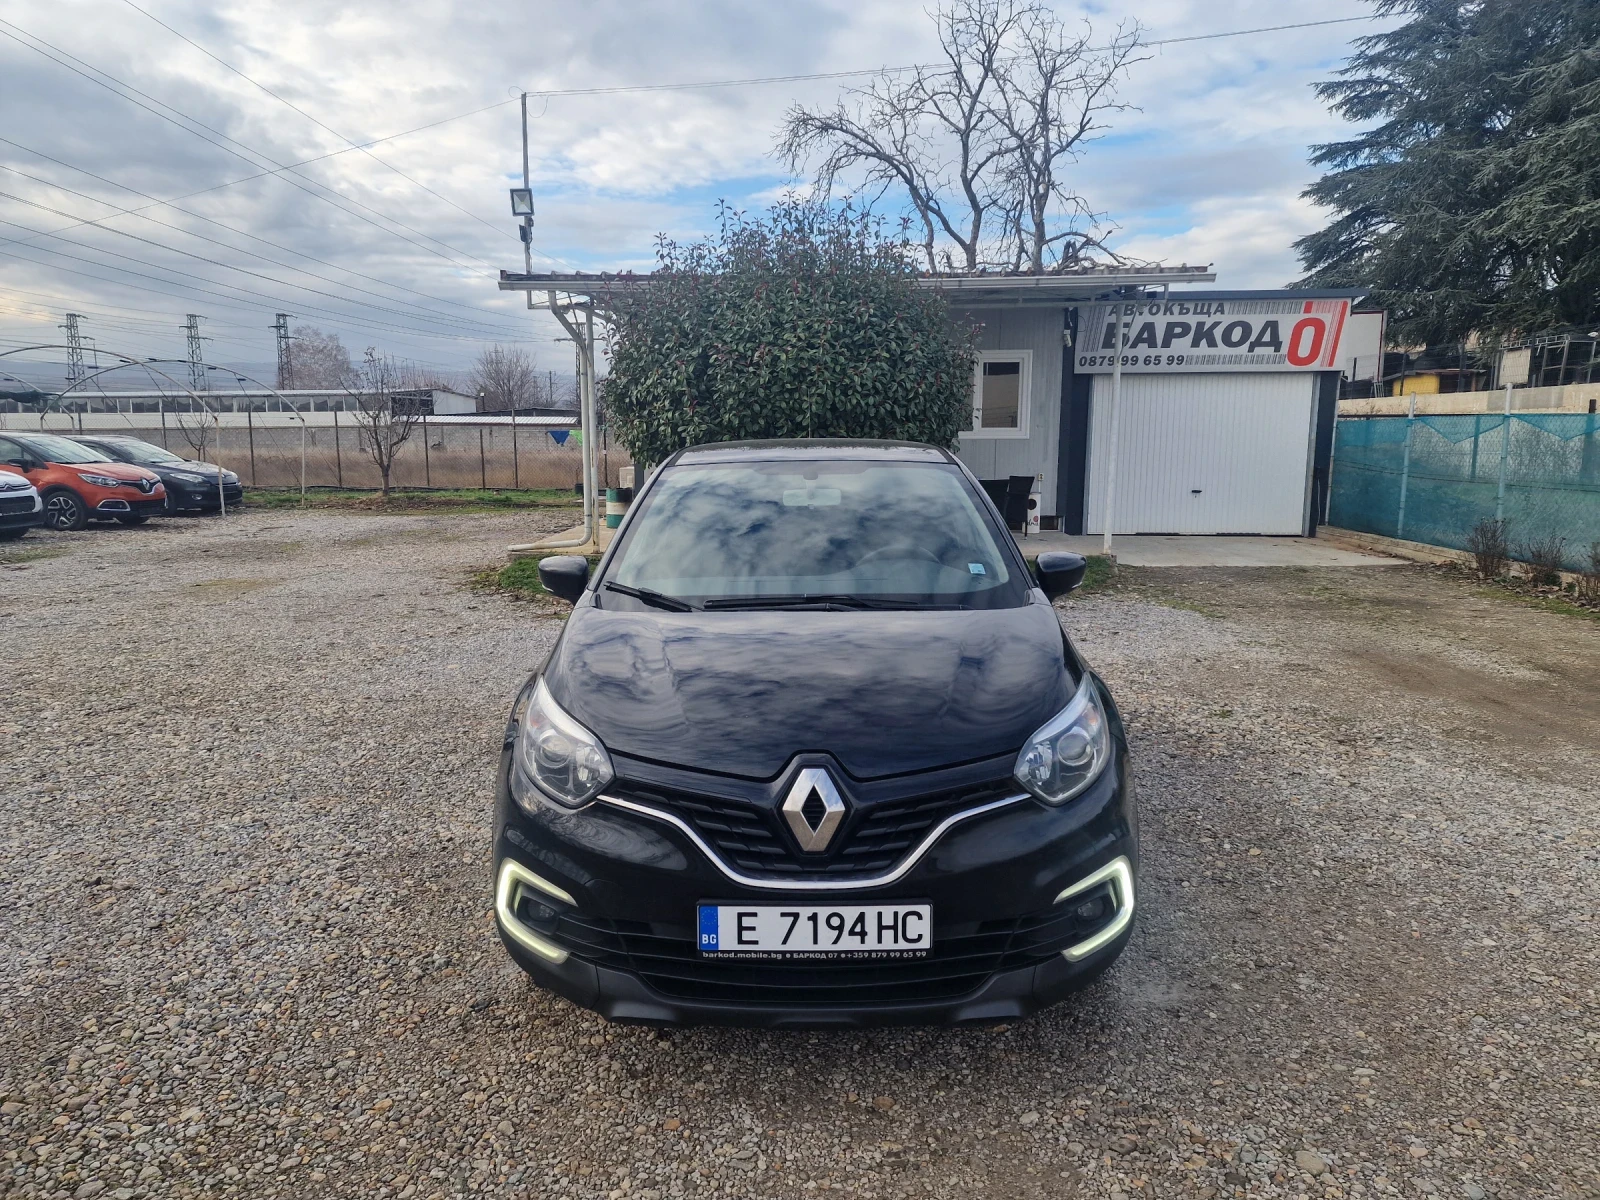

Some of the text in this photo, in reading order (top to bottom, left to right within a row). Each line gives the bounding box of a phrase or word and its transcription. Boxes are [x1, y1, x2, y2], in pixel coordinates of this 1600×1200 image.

[1108, 302, 1225, 318] АВОКЪЩА
[1101, 320, 1283, 353] БАРКОД
[1078, 354, 1185, 367] 0879 99 65 99
[736, 910, 924, 945] E 7194 HC
[701, 934, 717, 945] BG
[702, 951, 783, 960] barkod.mobile.bg
